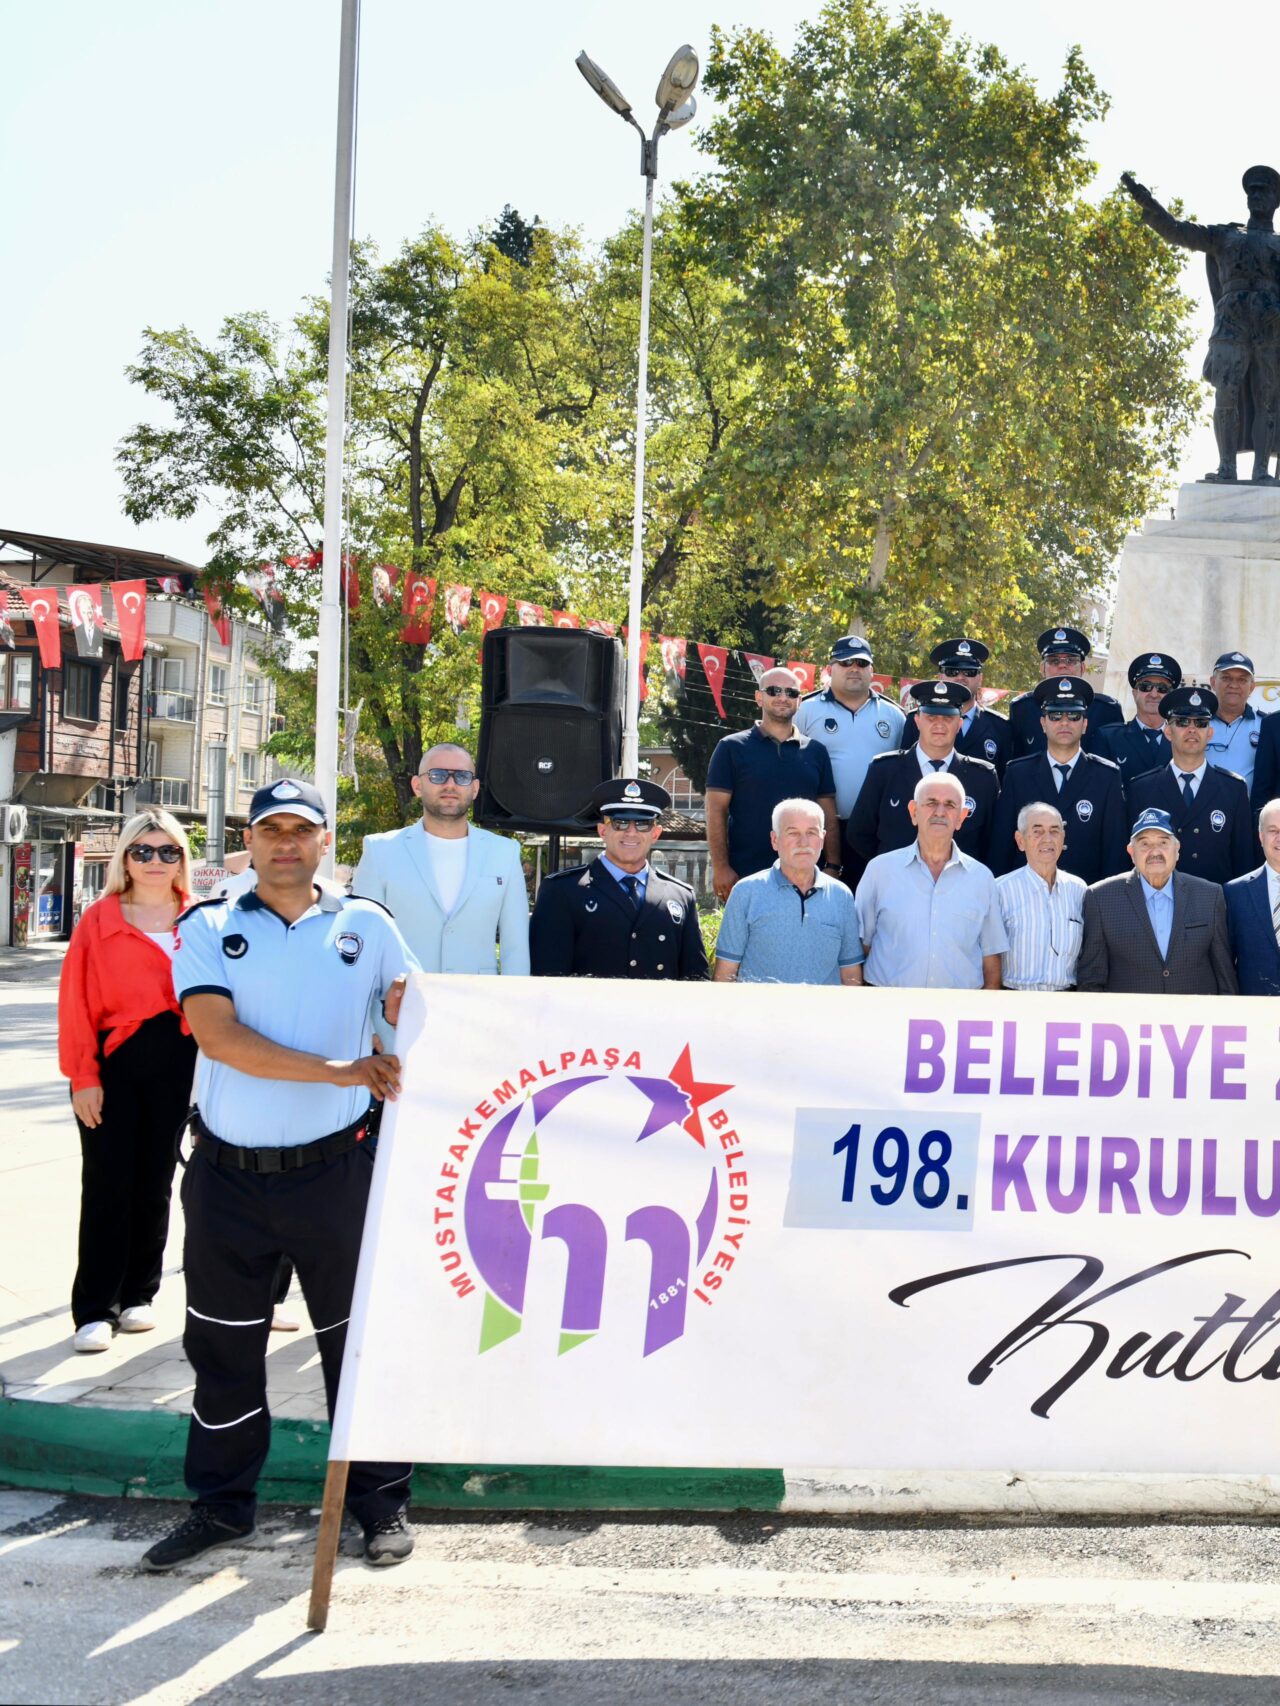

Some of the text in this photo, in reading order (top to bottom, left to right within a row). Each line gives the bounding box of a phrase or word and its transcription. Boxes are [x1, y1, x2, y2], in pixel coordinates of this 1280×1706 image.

[538, 761, 553, 769] RCF
[433, 1047, 643, 1298] MUSTAFAKEMALPAŞA
[693, 1109, 751, 1306] BELEDİYESİ
[832, 1123, 969, 1210] 198.
[649, 1277, 687, 1310] 1881
